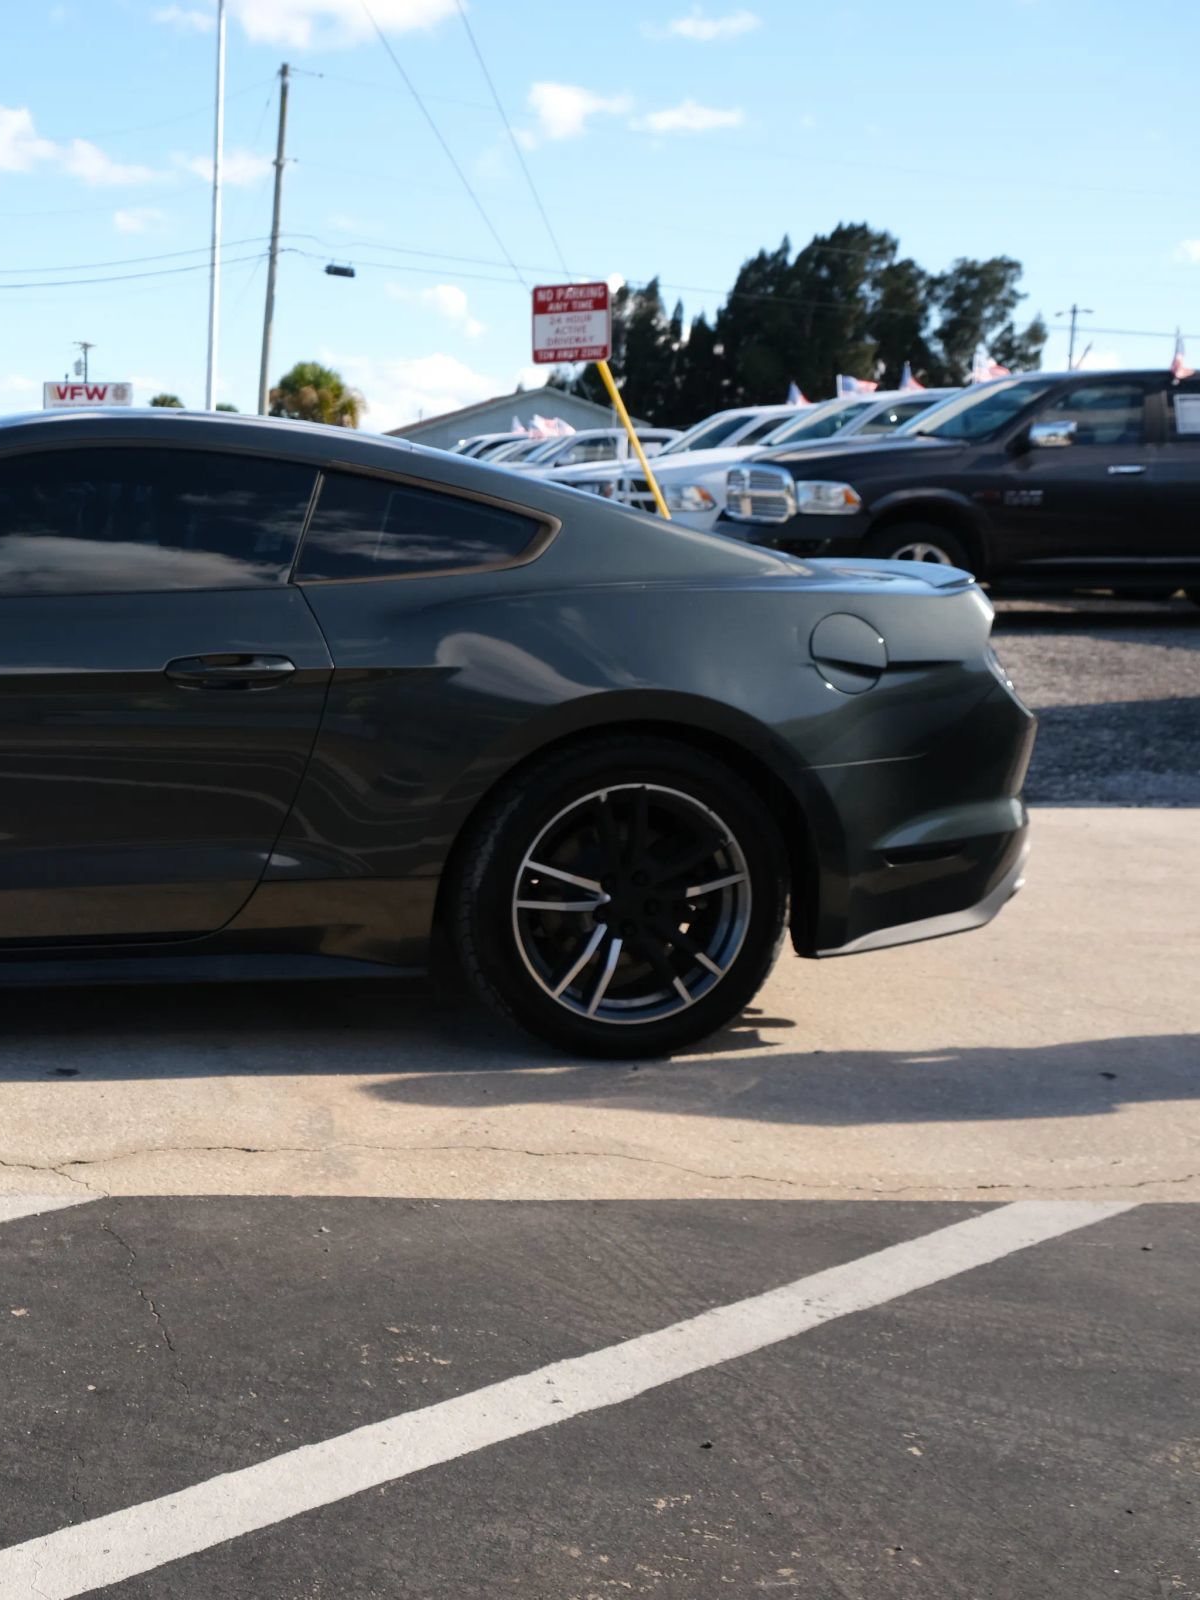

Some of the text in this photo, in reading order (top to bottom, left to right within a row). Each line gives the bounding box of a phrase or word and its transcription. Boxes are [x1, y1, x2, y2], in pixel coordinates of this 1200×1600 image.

[537, 286, 605, 302] NO PARKING
[547, 299, 593, 312] ANY TIME
[549, 314, 592, 325] 24 HOUR
[555, 325, 587, 335] ACTIVE
[546, 335, 594, 346] DRIVEWAY
[537, 347, 603, 360] TOW AWAY ZONE
[56, 384, 108, 401] VFW
